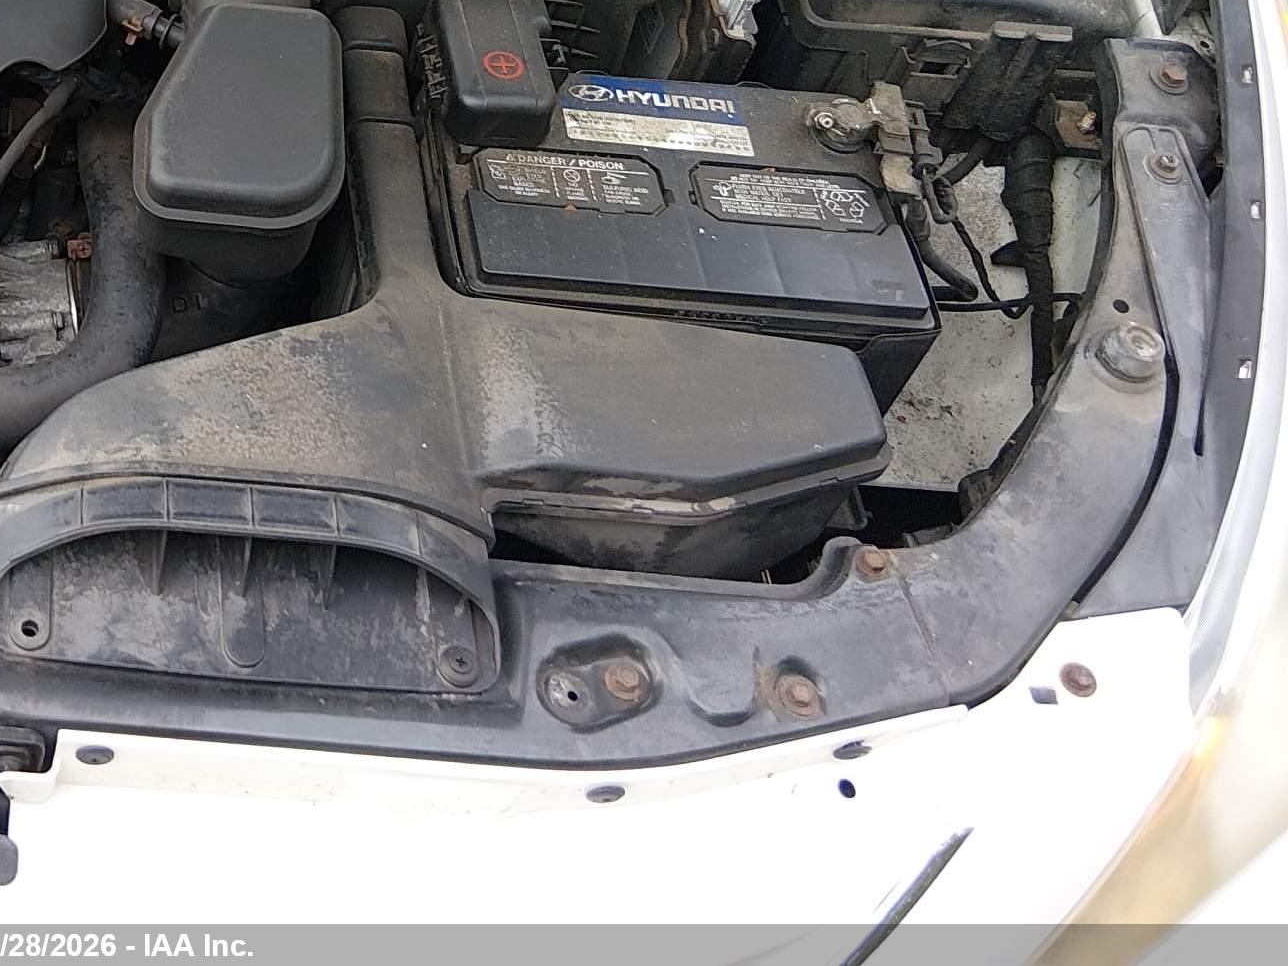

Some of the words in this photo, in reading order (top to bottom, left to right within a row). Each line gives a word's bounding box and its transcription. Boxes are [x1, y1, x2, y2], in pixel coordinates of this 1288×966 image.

[615, 88, 736, 114] HYUNDAI
[516, 154, 568, 166] DANGER
[578, 159, 624, 171] POISON
